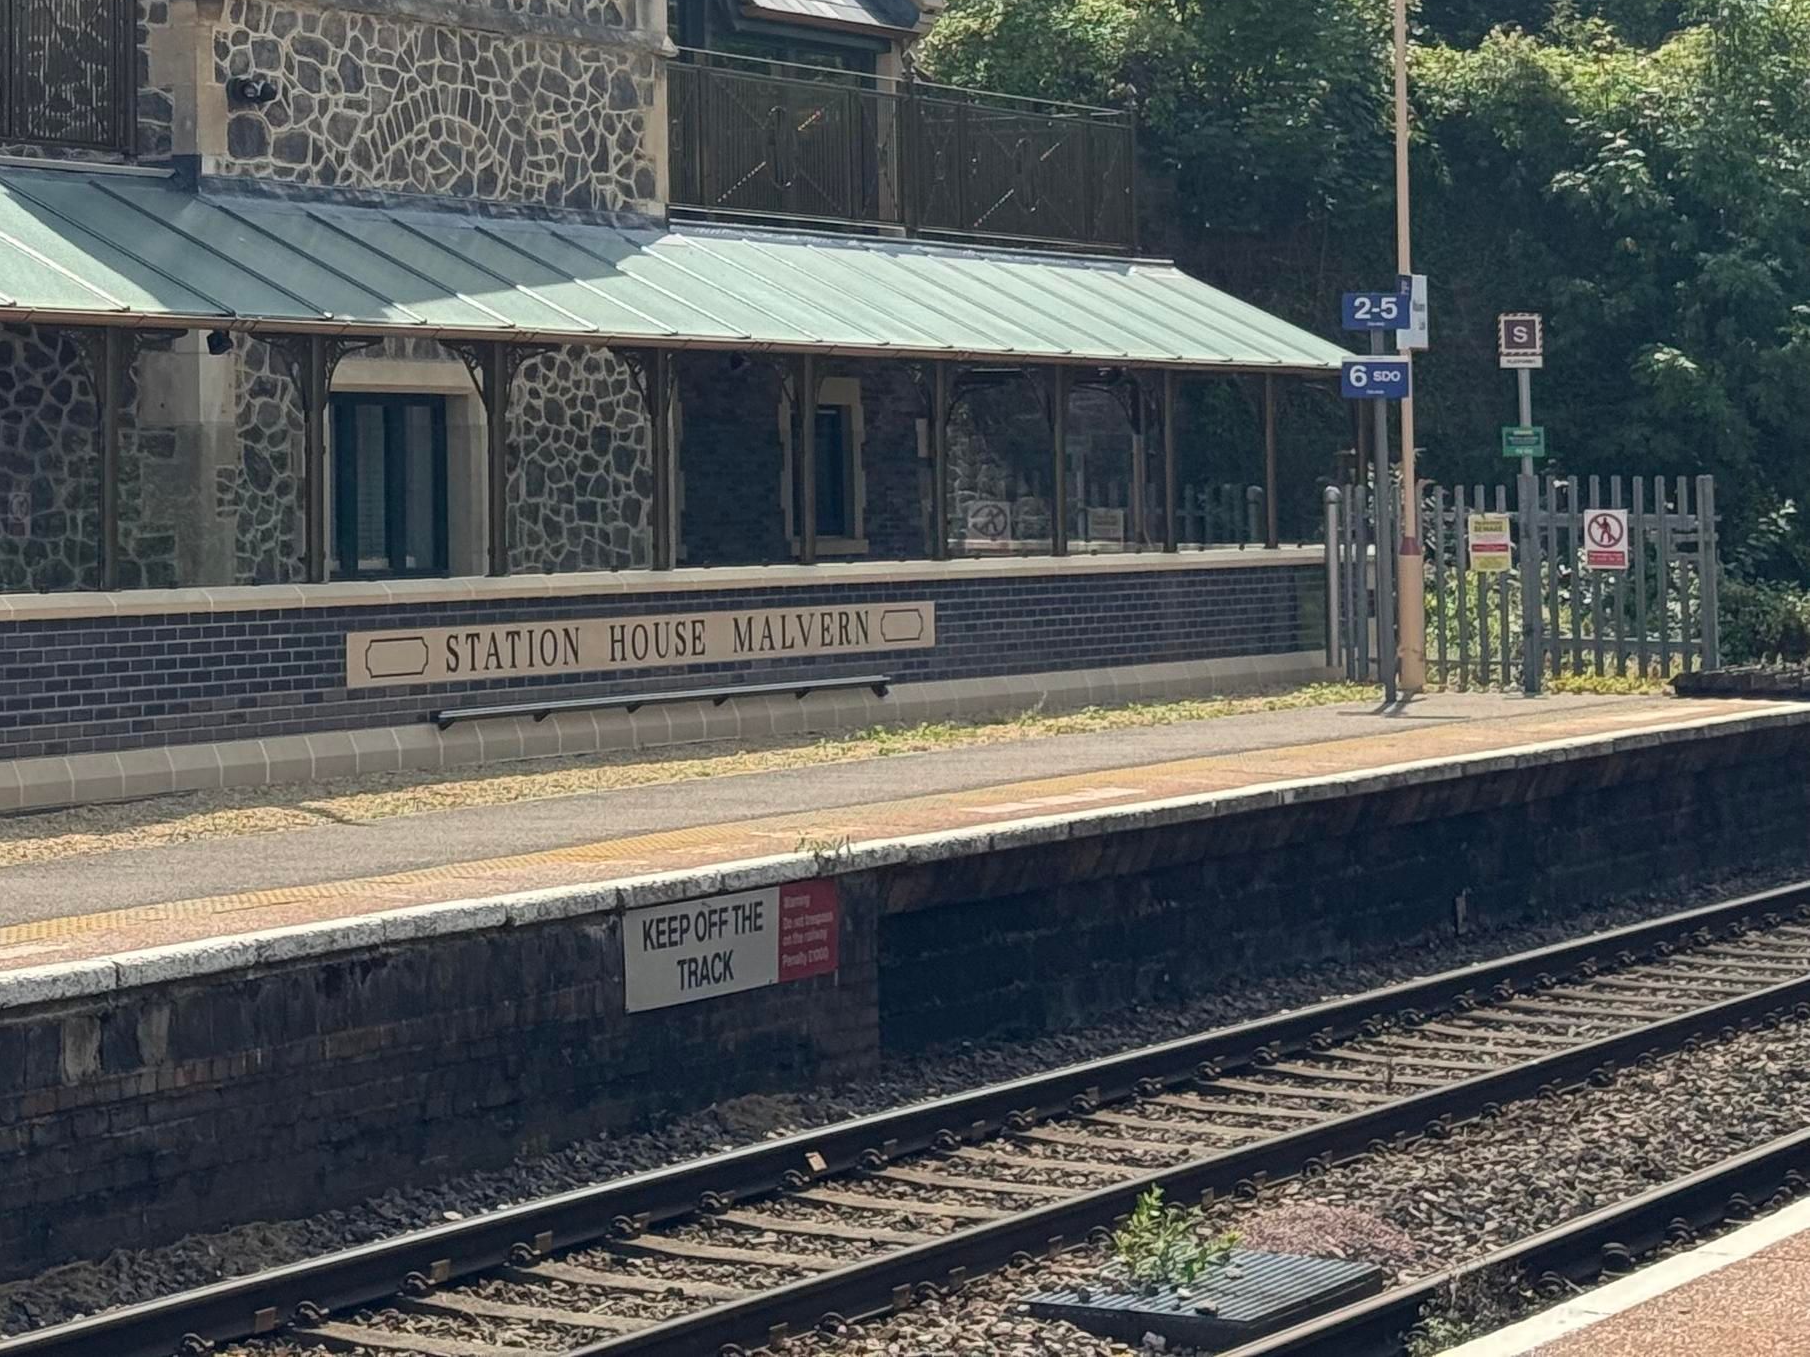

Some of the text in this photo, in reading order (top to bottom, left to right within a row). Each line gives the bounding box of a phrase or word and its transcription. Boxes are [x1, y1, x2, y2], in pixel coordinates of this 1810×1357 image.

[1353, 296, 1399, 320] 2-5
[1512, 325, 1528, 343] S
[1349, 364, 1402, 388] 6 SDO
[445, 610, 869, 674] STATION HOUSE MALVERN
[642, 900, 764, 952] KEEP OFF THE
[676, 948, 735, 992] TRACK
